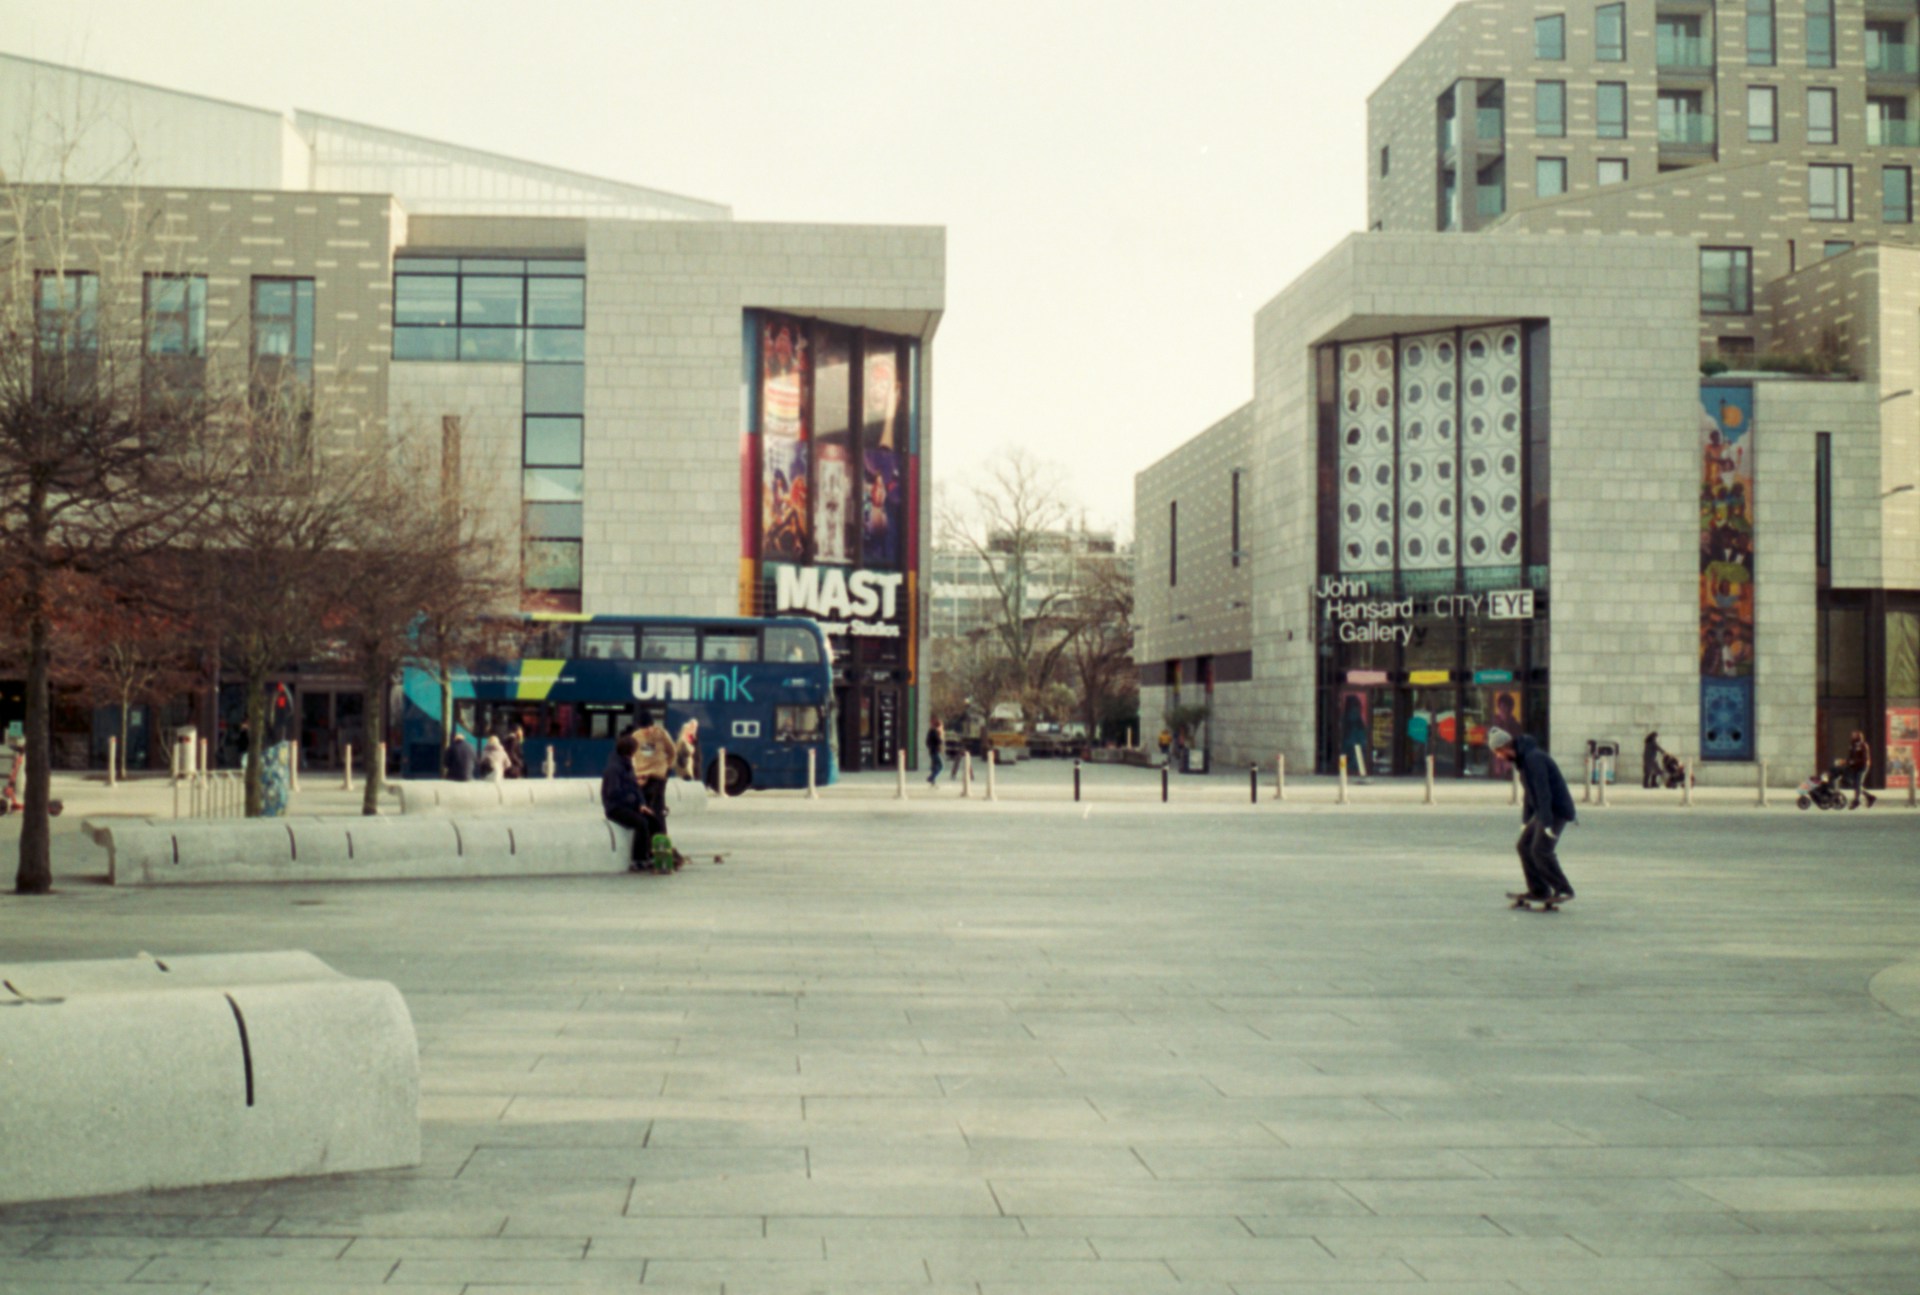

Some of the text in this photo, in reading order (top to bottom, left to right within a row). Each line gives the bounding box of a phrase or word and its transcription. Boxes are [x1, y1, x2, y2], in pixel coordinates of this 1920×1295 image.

[776, 565, 903, 619] MAST
[1317, 577, 1367, 598] John
[1326, 596, 1413, 618] Hansard
[1434, 592, 1532, 618] CITY EYE
[1339, 621, 1413, 646] Gallery
[633, 665, 754, 701] unilink
